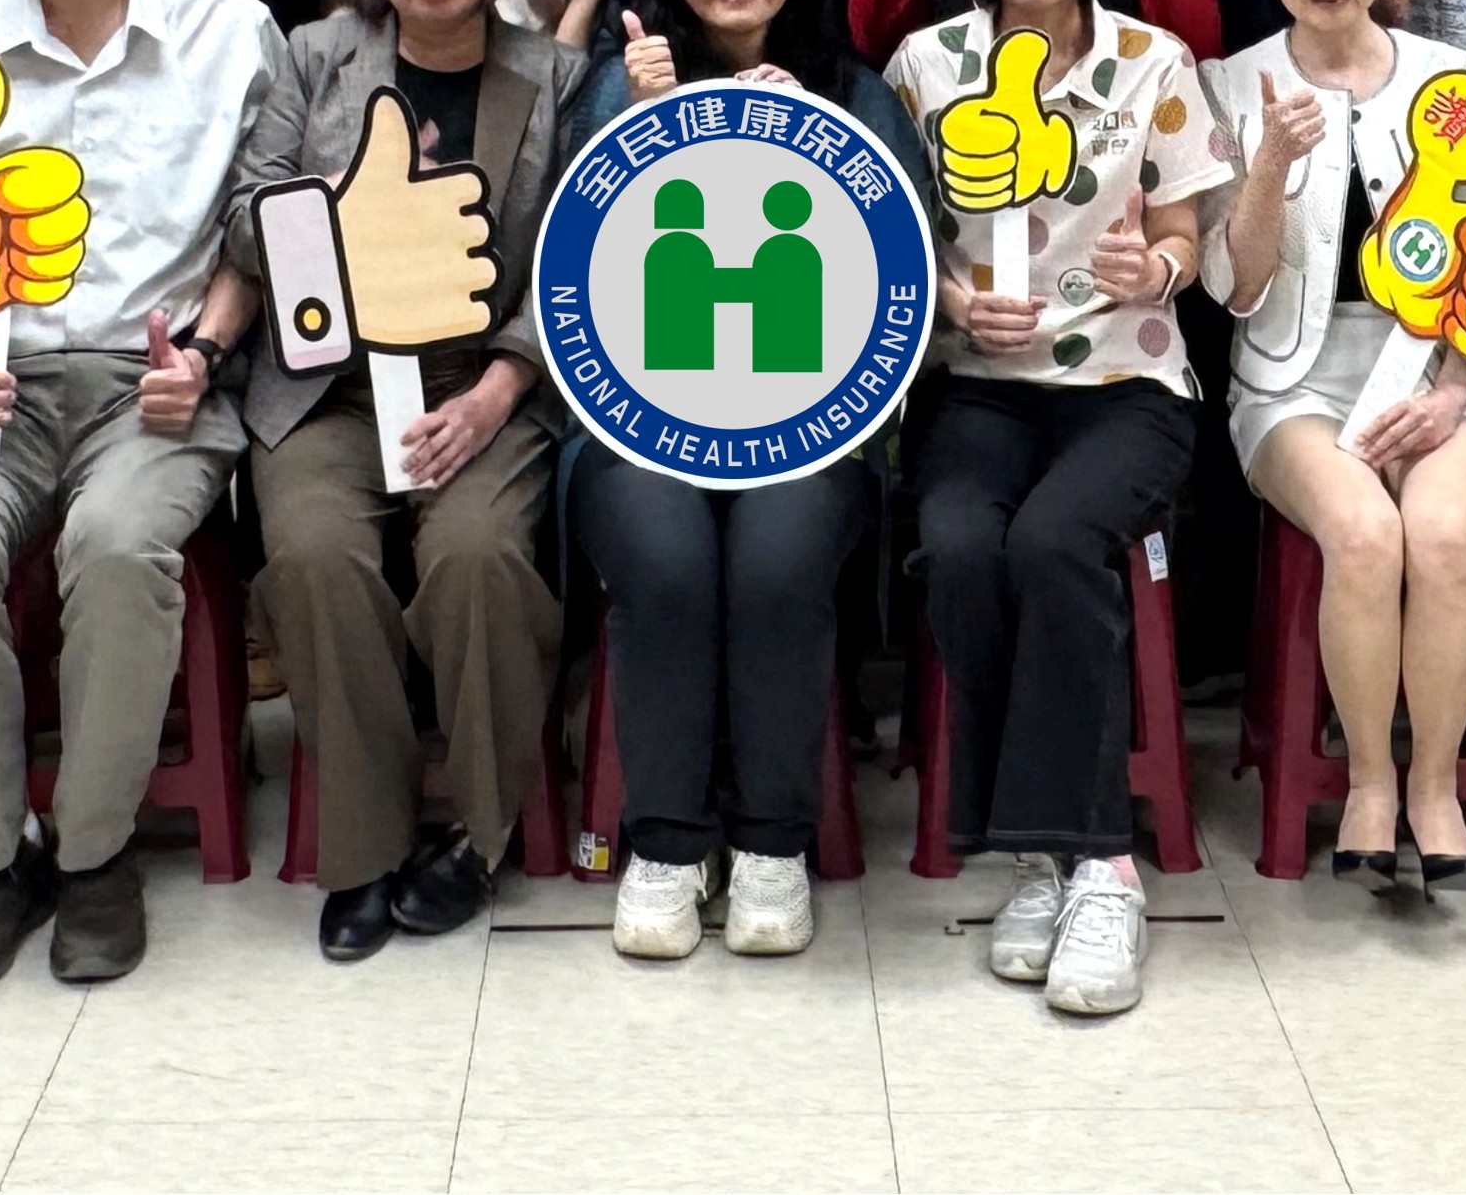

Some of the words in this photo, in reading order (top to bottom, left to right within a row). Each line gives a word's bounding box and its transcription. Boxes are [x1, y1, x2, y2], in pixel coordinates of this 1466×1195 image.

[574, 96, 894, 210] 全民健康保險
[551, 286, 640, 439] NATIONAL
[655, 425, 788, 467] HEALTH
[797, 284, 917, 452] INSURANCE
